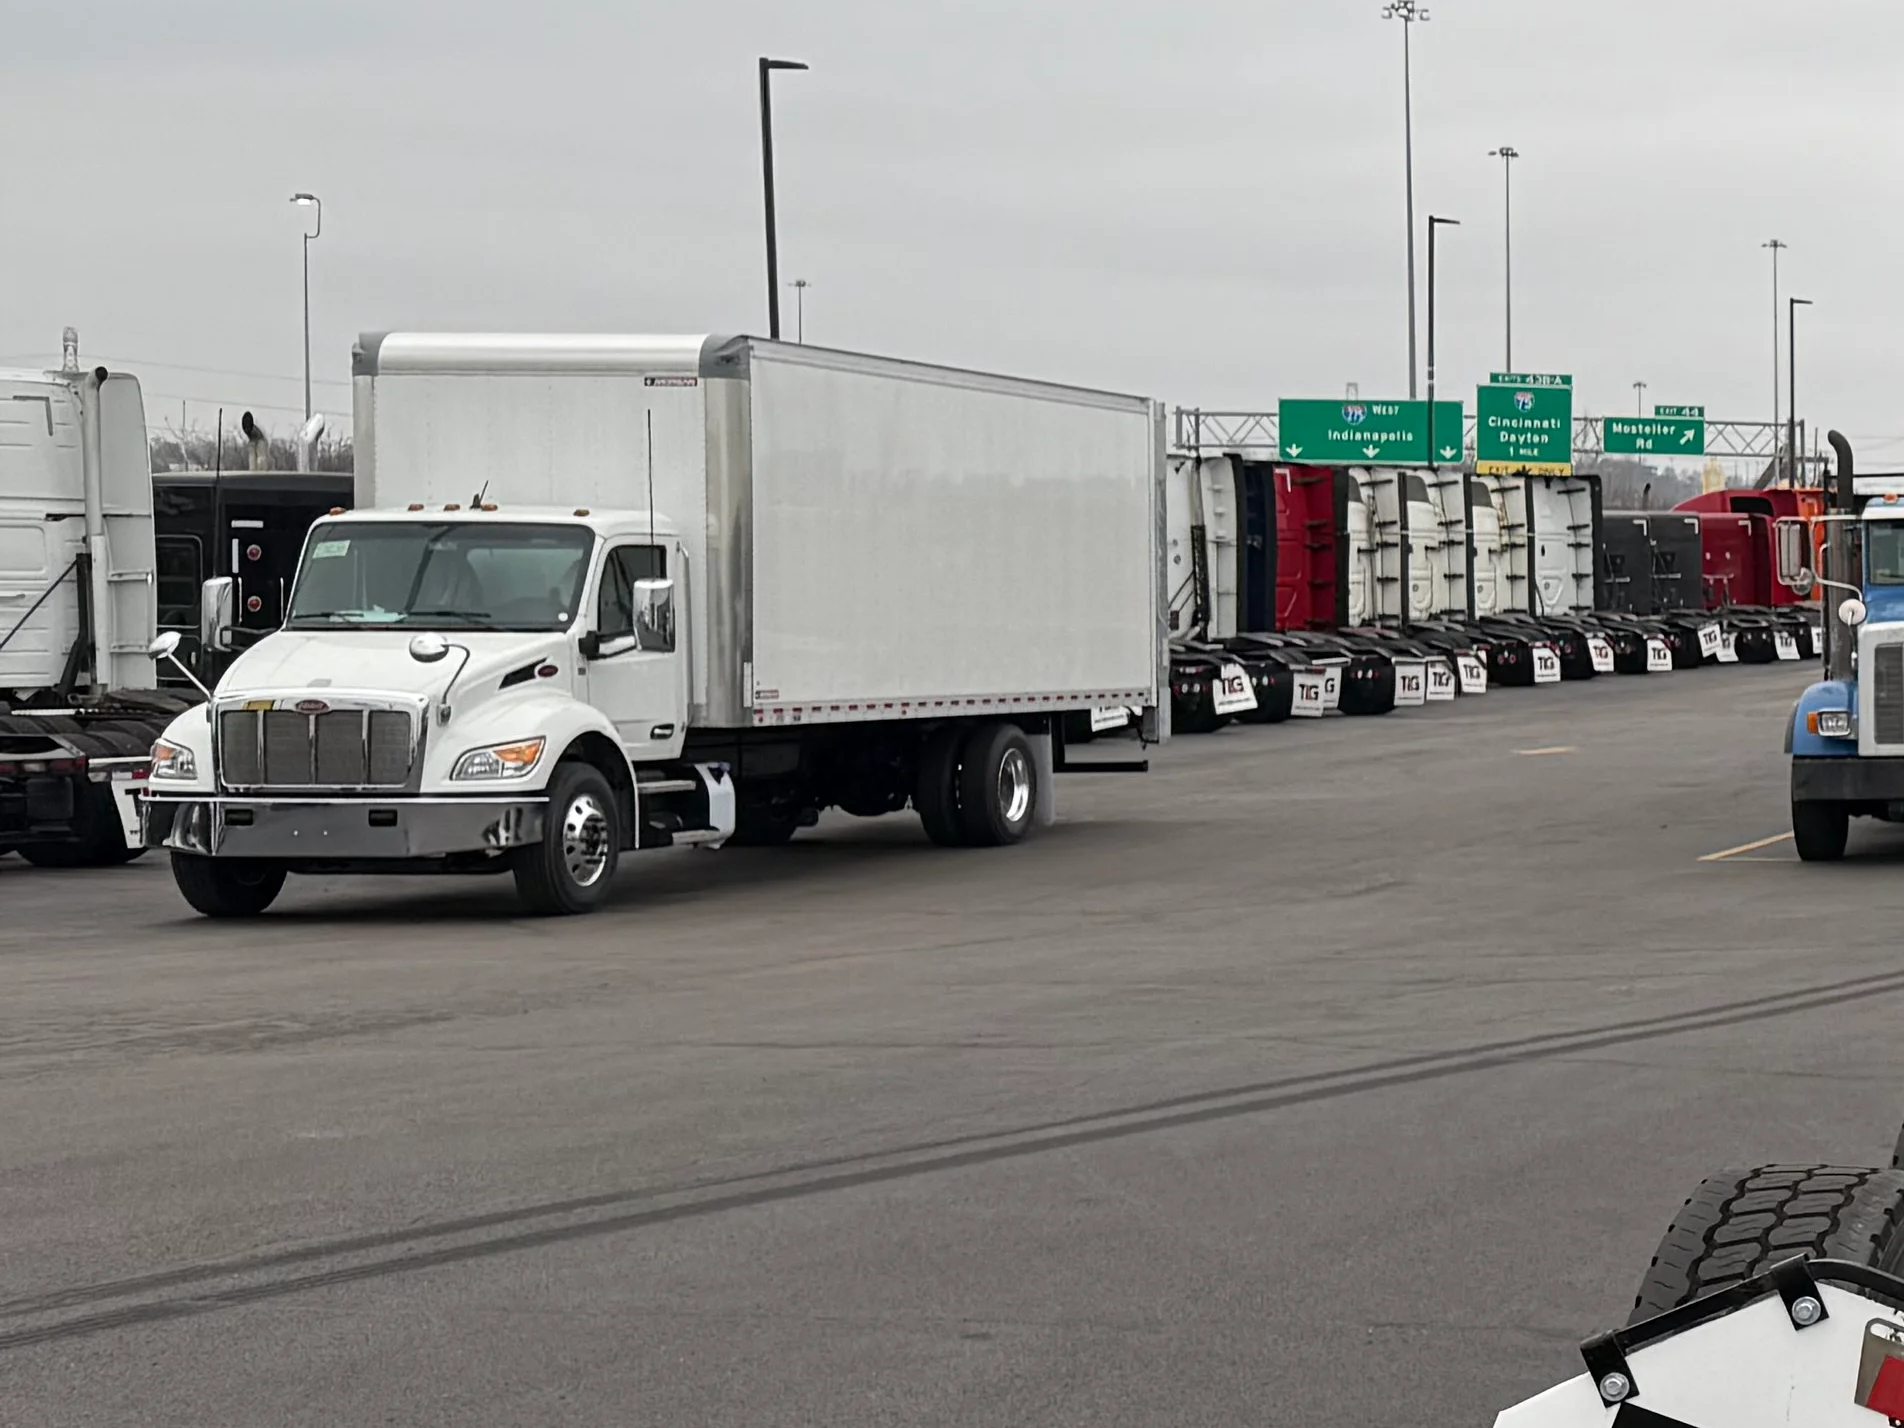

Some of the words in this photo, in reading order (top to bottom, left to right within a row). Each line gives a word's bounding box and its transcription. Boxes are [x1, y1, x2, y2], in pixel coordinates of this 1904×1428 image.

[1371, 404, 1400, 416] WEST
[1488, 415, 1561, 429] Cincinnati
[1612, 421, 1676, 435] Mosteller
[1328, 429, 1414, 444] Indianapolis
[1500, 430, 1549, 445] Dayton
[1635, 436, 1653, 450] Rd
[1519, 447, 1539, 457] MILE
[1298, 684, 1319, 701] TLG
